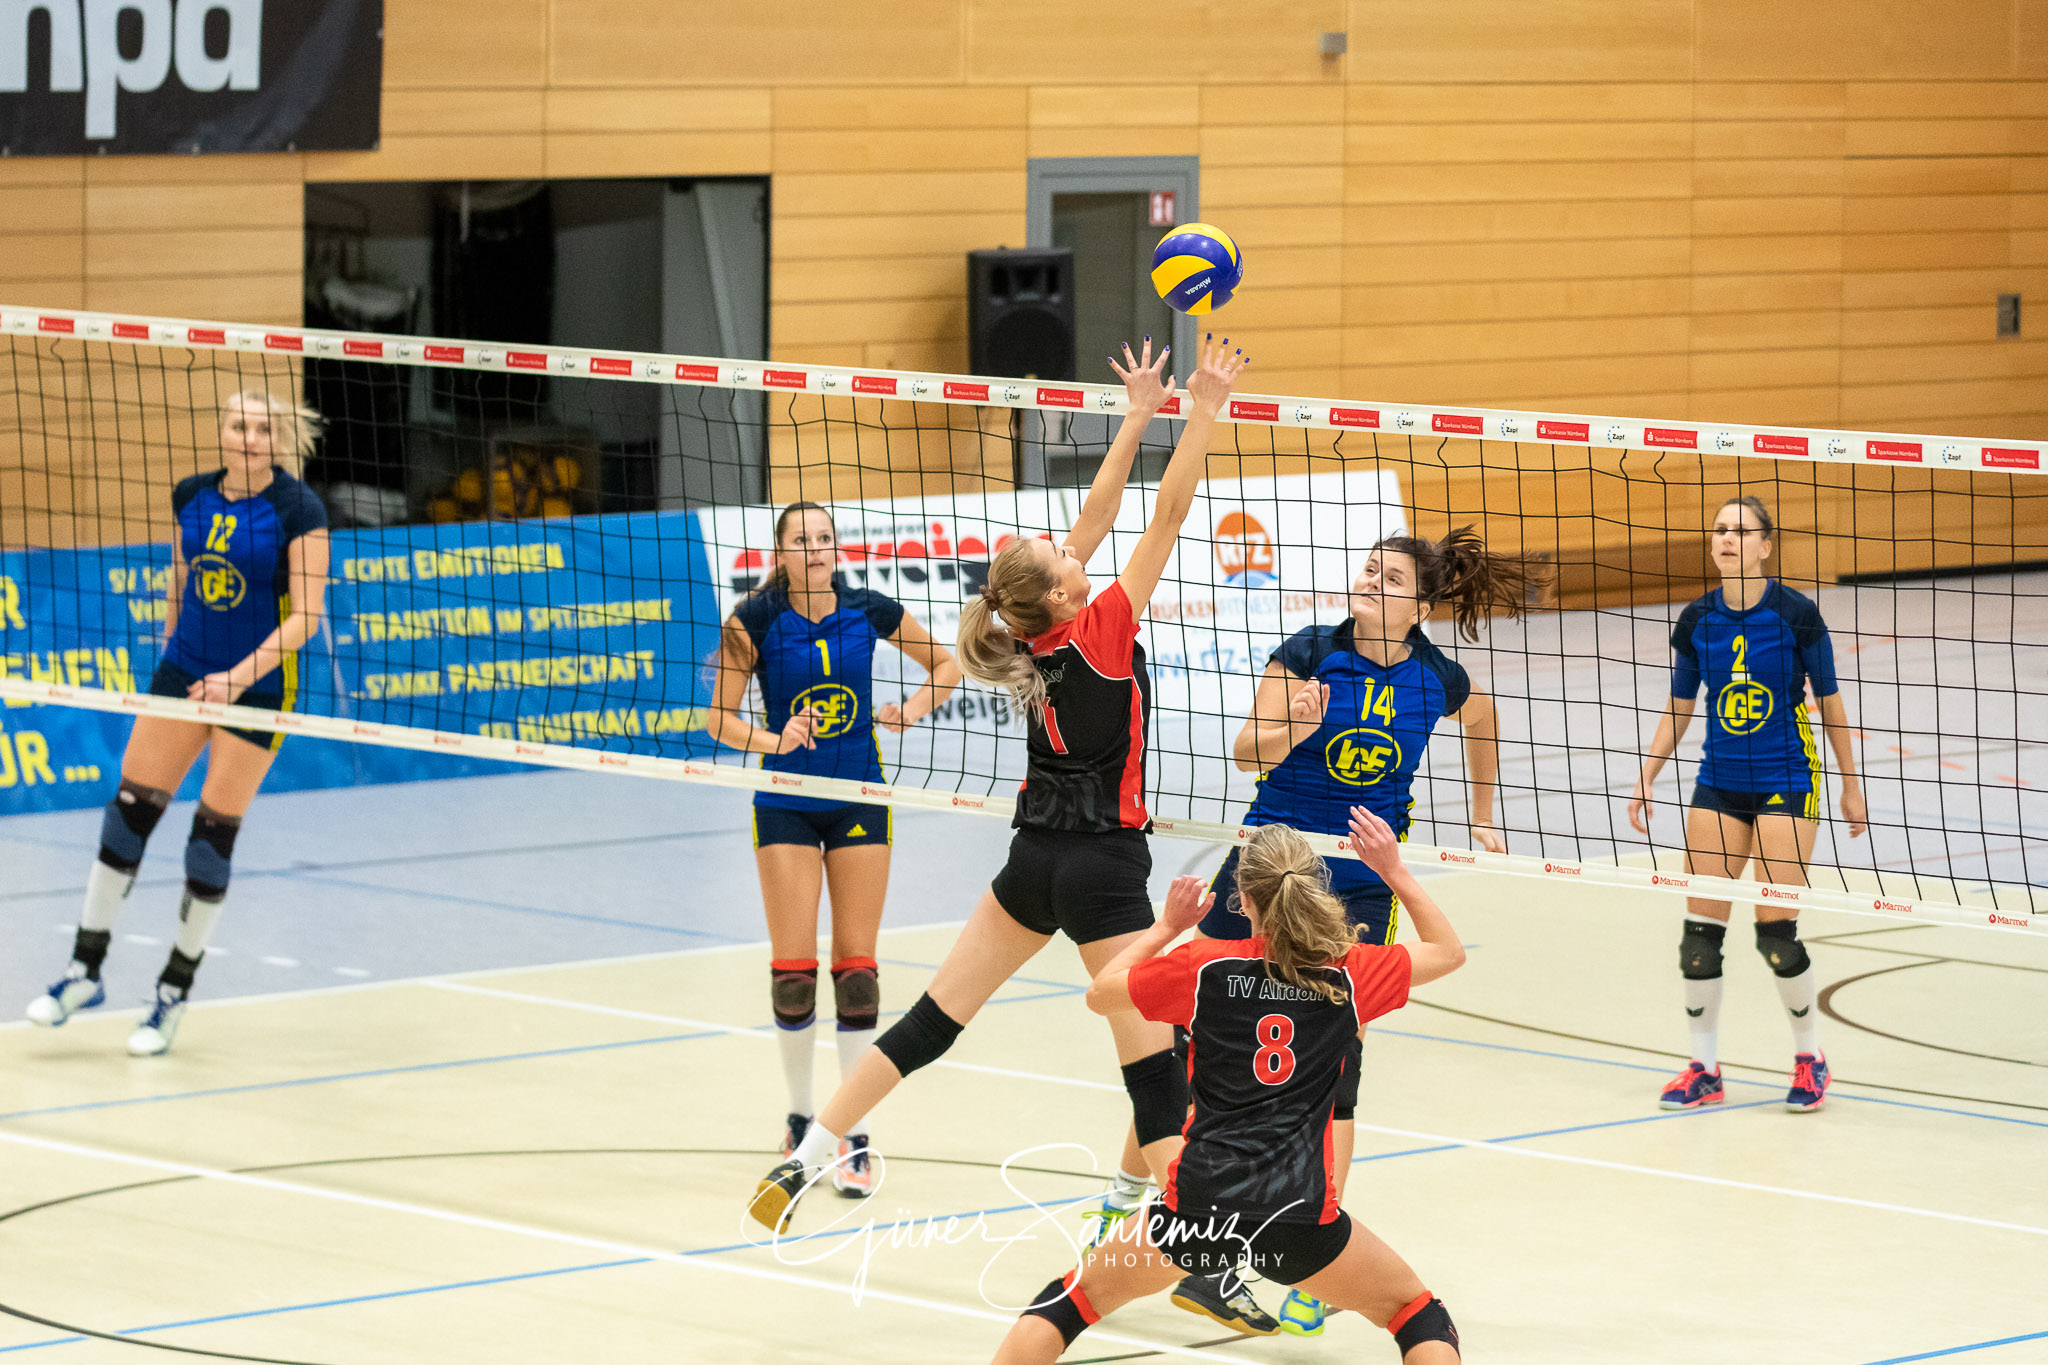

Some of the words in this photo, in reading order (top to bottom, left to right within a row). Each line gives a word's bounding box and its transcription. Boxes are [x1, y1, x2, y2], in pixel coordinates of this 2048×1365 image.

[1567, 430, 1585, 438] Nürnberg
[1675, 437, 1694, 445] Nürnberg
[1721, 440, 1734, 448] Zapf
[1786, 444, 1804, 452] Nürnberg
[1898, 450, 1918, 458] Nürnberg
[1993, 455, 2014, 463] Sparkasse
[2015, 457, 2035, 465] Nürnberg
[206, 513, 237, 552] 12
[815, 639, 831, 676] 1
[1731, 634, 1749, 674] 2
[1361, 676, 1397, 727] 14
[867, 788, 892, 797] Marmot
[959, 798, 984, 807] Marmot
[1152, 821, 1174, 830] armot
[1448, 854, 1475, 864] Marmot
[1552, 865, 1581, 875] Marmot
[1659, 876, 1688, 887] Marmot
[1769, 890, 1799, 900] Marmot
[1882, 901, 1912, 912] Marmot
[1997, 916, 2028, 927] Marmot
[1227, 975, 1256, 998] TV
[1253, 1013, 1296, 1086] 8
